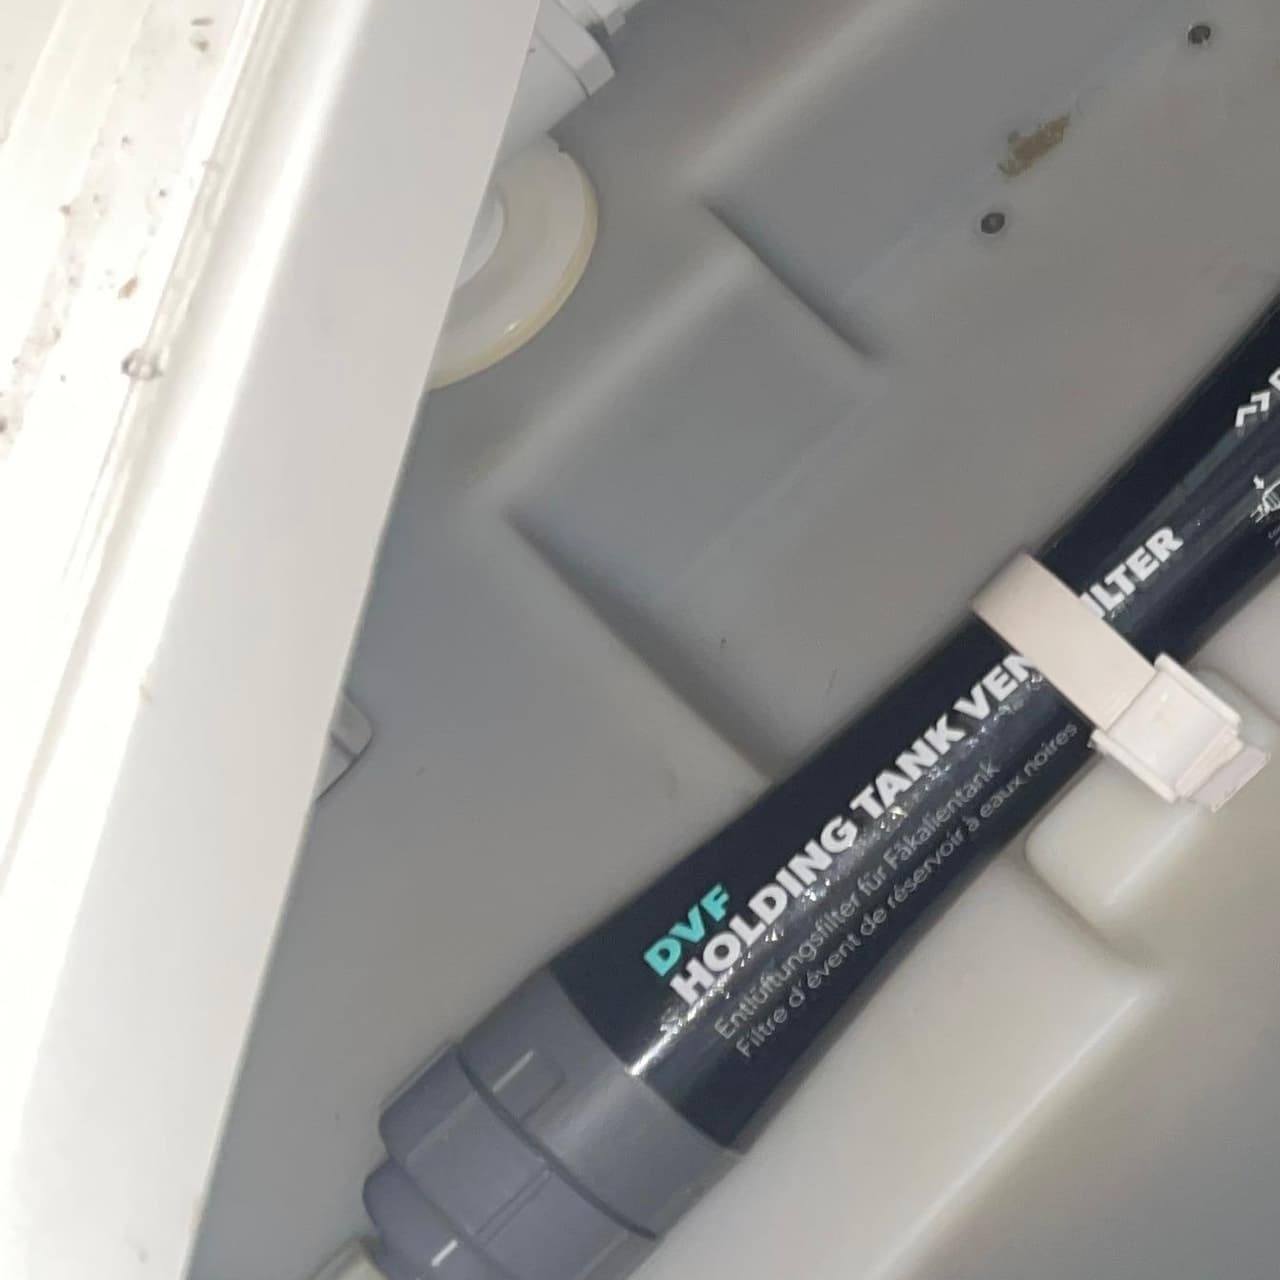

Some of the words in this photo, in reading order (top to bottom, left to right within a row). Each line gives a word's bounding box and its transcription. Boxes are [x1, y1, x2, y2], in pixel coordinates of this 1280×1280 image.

[668, 815, 857, 1011] HOLDING
[850, 714, 966, 820] TANK
[954, 651, 1042, 725] VEN
[1080, 524, 1186, 622] ILTER
[713, 887, 863, 1043] Entlüftungsfilter
[857, 864, 890, 901] für
[885, 759, 1000, 871] Fäkalientank
[735, 1003, 789, 1059] Filtre
[859, 905, 889, 940] de
[884, 829, 966, 914] réservoir
[979, 775, 1026, 824] eaux
[1022, 721, 1079, 781] noires
[642, 882, 731, 977] DVF
